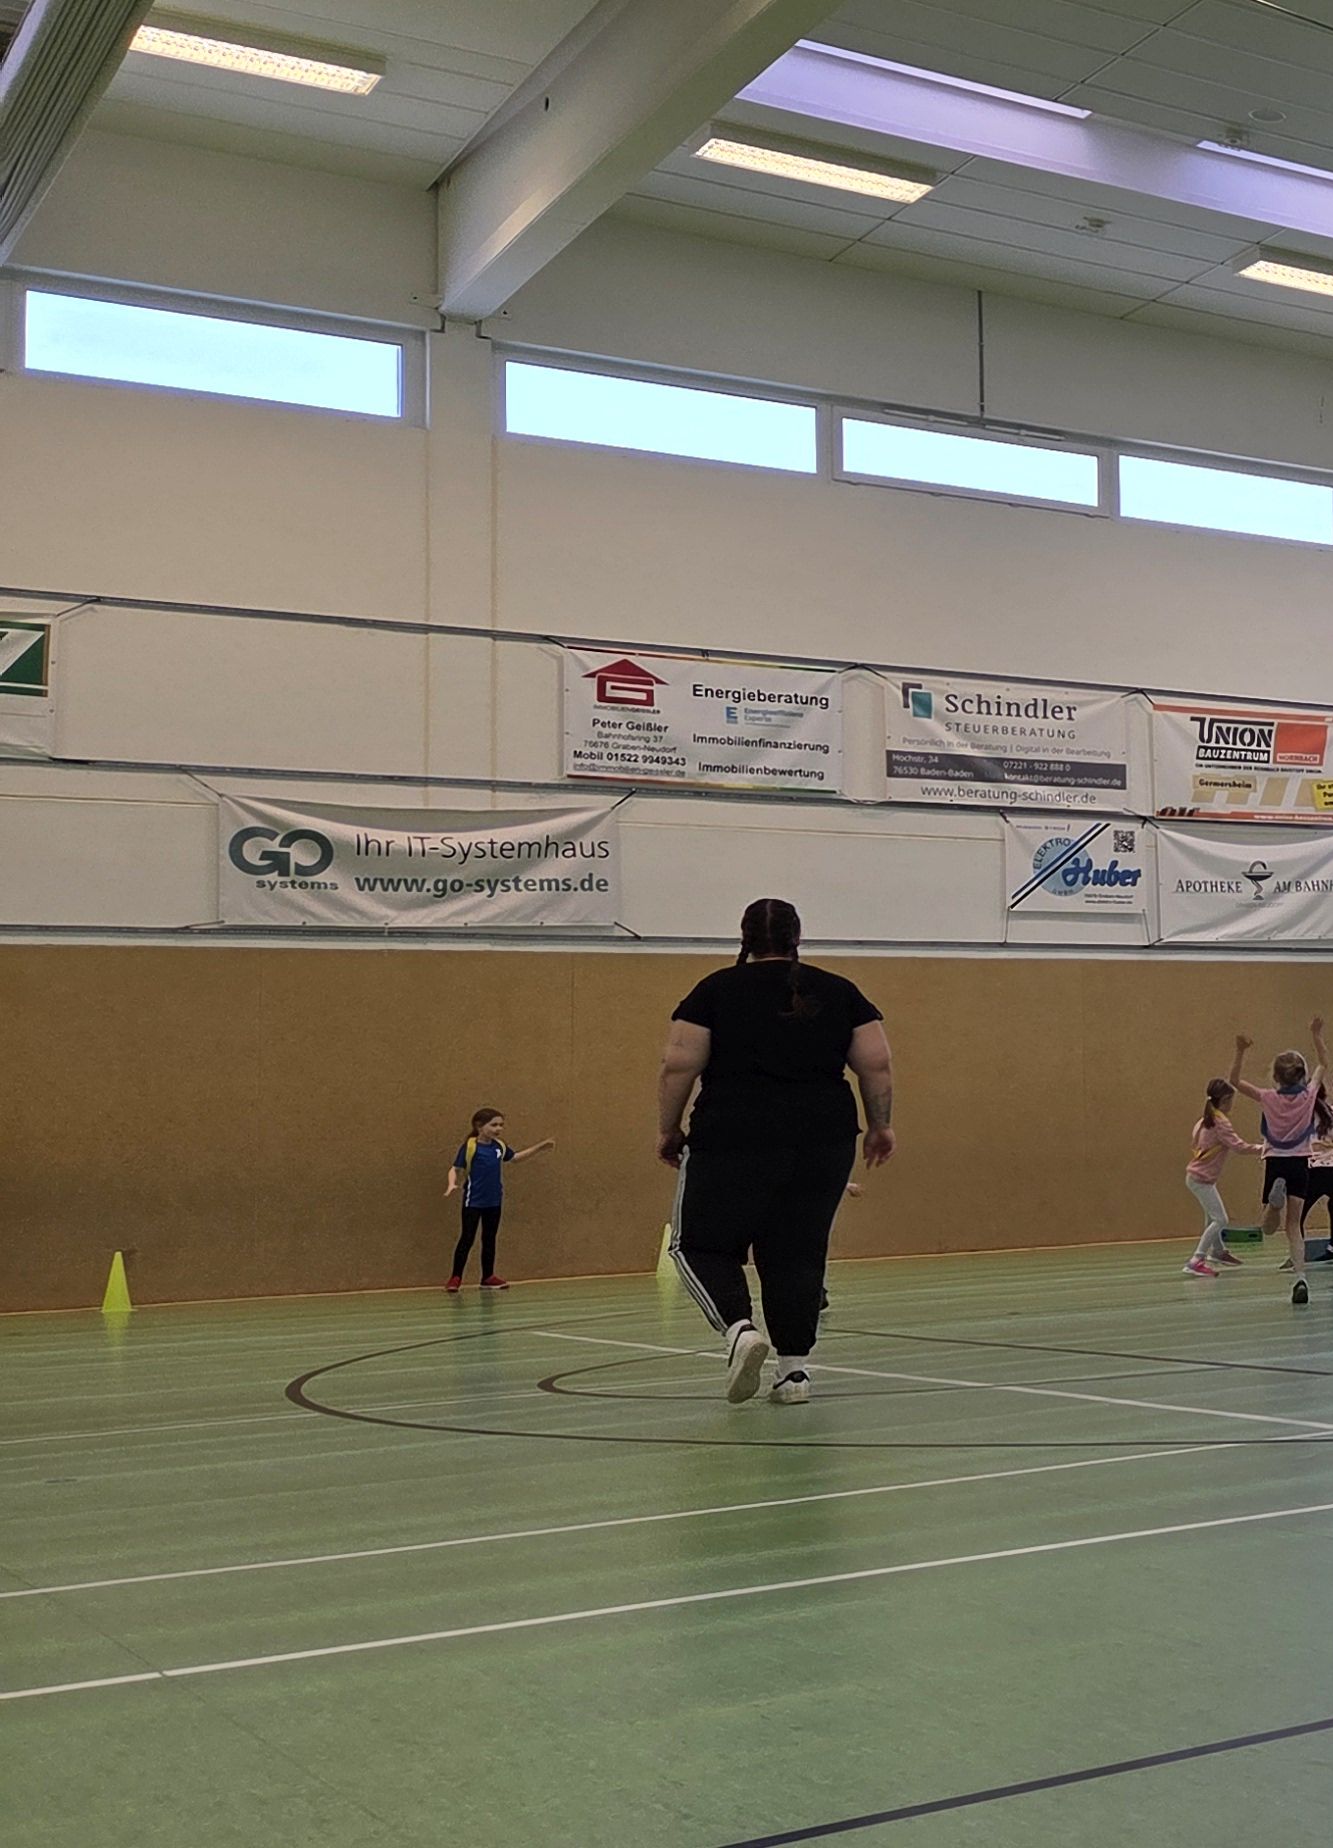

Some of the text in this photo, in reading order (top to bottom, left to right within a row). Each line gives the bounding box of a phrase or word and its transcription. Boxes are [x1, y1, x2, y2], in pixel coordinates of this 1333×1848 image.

[692, 684, 829, 709] Energieberatung
[944, 693, 1077, 721] Schindler
[592, 718, 669, 733] Peter Geißler
[945, 722, 1076, 740] STEUERBERATUNG
[1197, 717, 1274, 748] UNION
[692, 733, 829, 754] Immobilienfinanzierung
[573, 750, 604, 760] Mobil
[606, 752, 639, 763] 01522
[1198, 748, 1269, 761] BAUZENTRUM
[698, 762, 825, 781] Immobilienbewertung
[920, 767, 974, 778] Baden-Baden
[1003, 760, 1028, 770] 07221
[921, 785, 1097, 805] www.beratung-schindler.de
[228, 826, 334, 877] GO
[356, 833, 610, 865] Ihr IT-Systemhaus
[1033, 837, 1071, 870] ELEKTRO
[1061, 858, 1142, 887] Huber
[256, 879, 340, 892] systems
[355, 872, 610, 898] www.go-systems.de
[1175, 879, 1243, 894] APOTHEKE
[1272, 880, 1292, 894] AM
